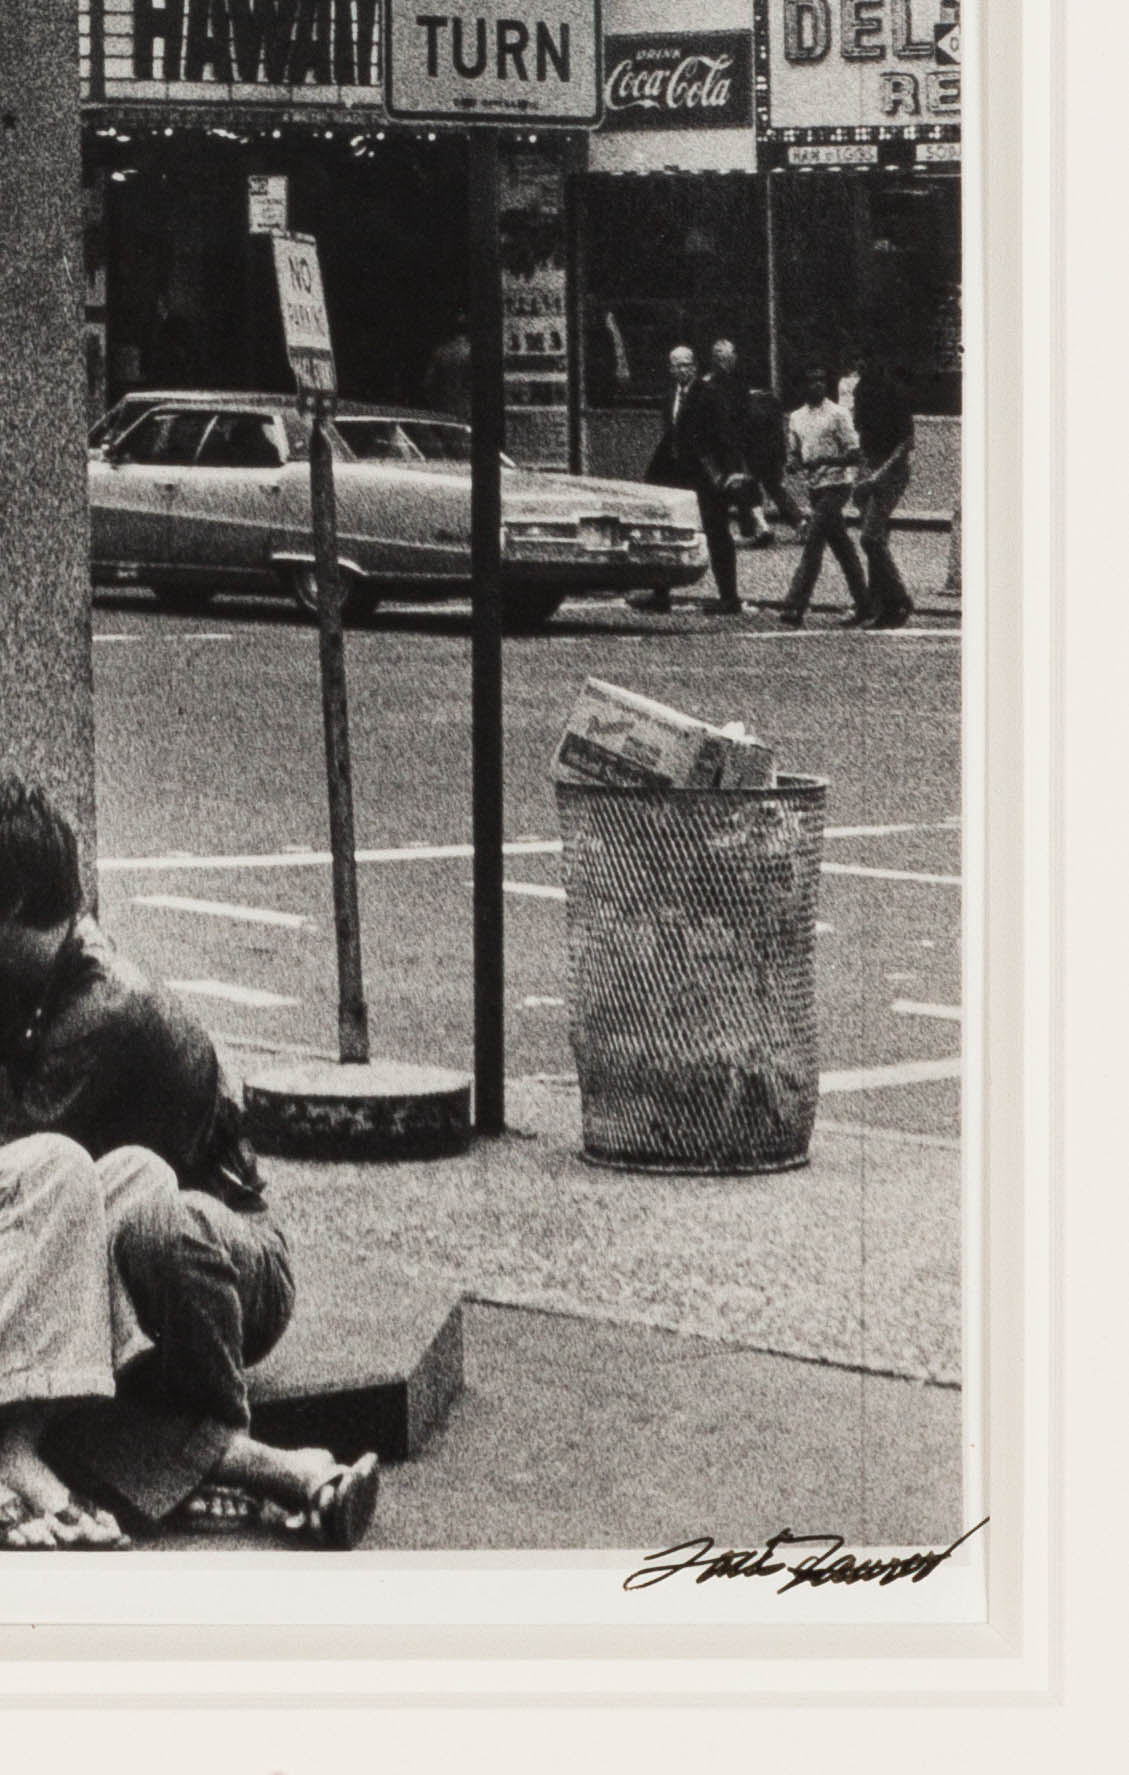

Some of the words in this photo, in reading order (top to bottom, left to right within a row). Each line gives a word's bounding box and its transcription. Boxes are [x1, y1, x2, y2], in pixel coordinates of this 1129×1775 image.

[417, 16, 571, 83] TURN
[635, 47, 682, 61] DRINK
[603, 54, 734, 111] Coca-Cola
[880, 71, 960, 116] RE
[287, 256, 312, 295] NO
